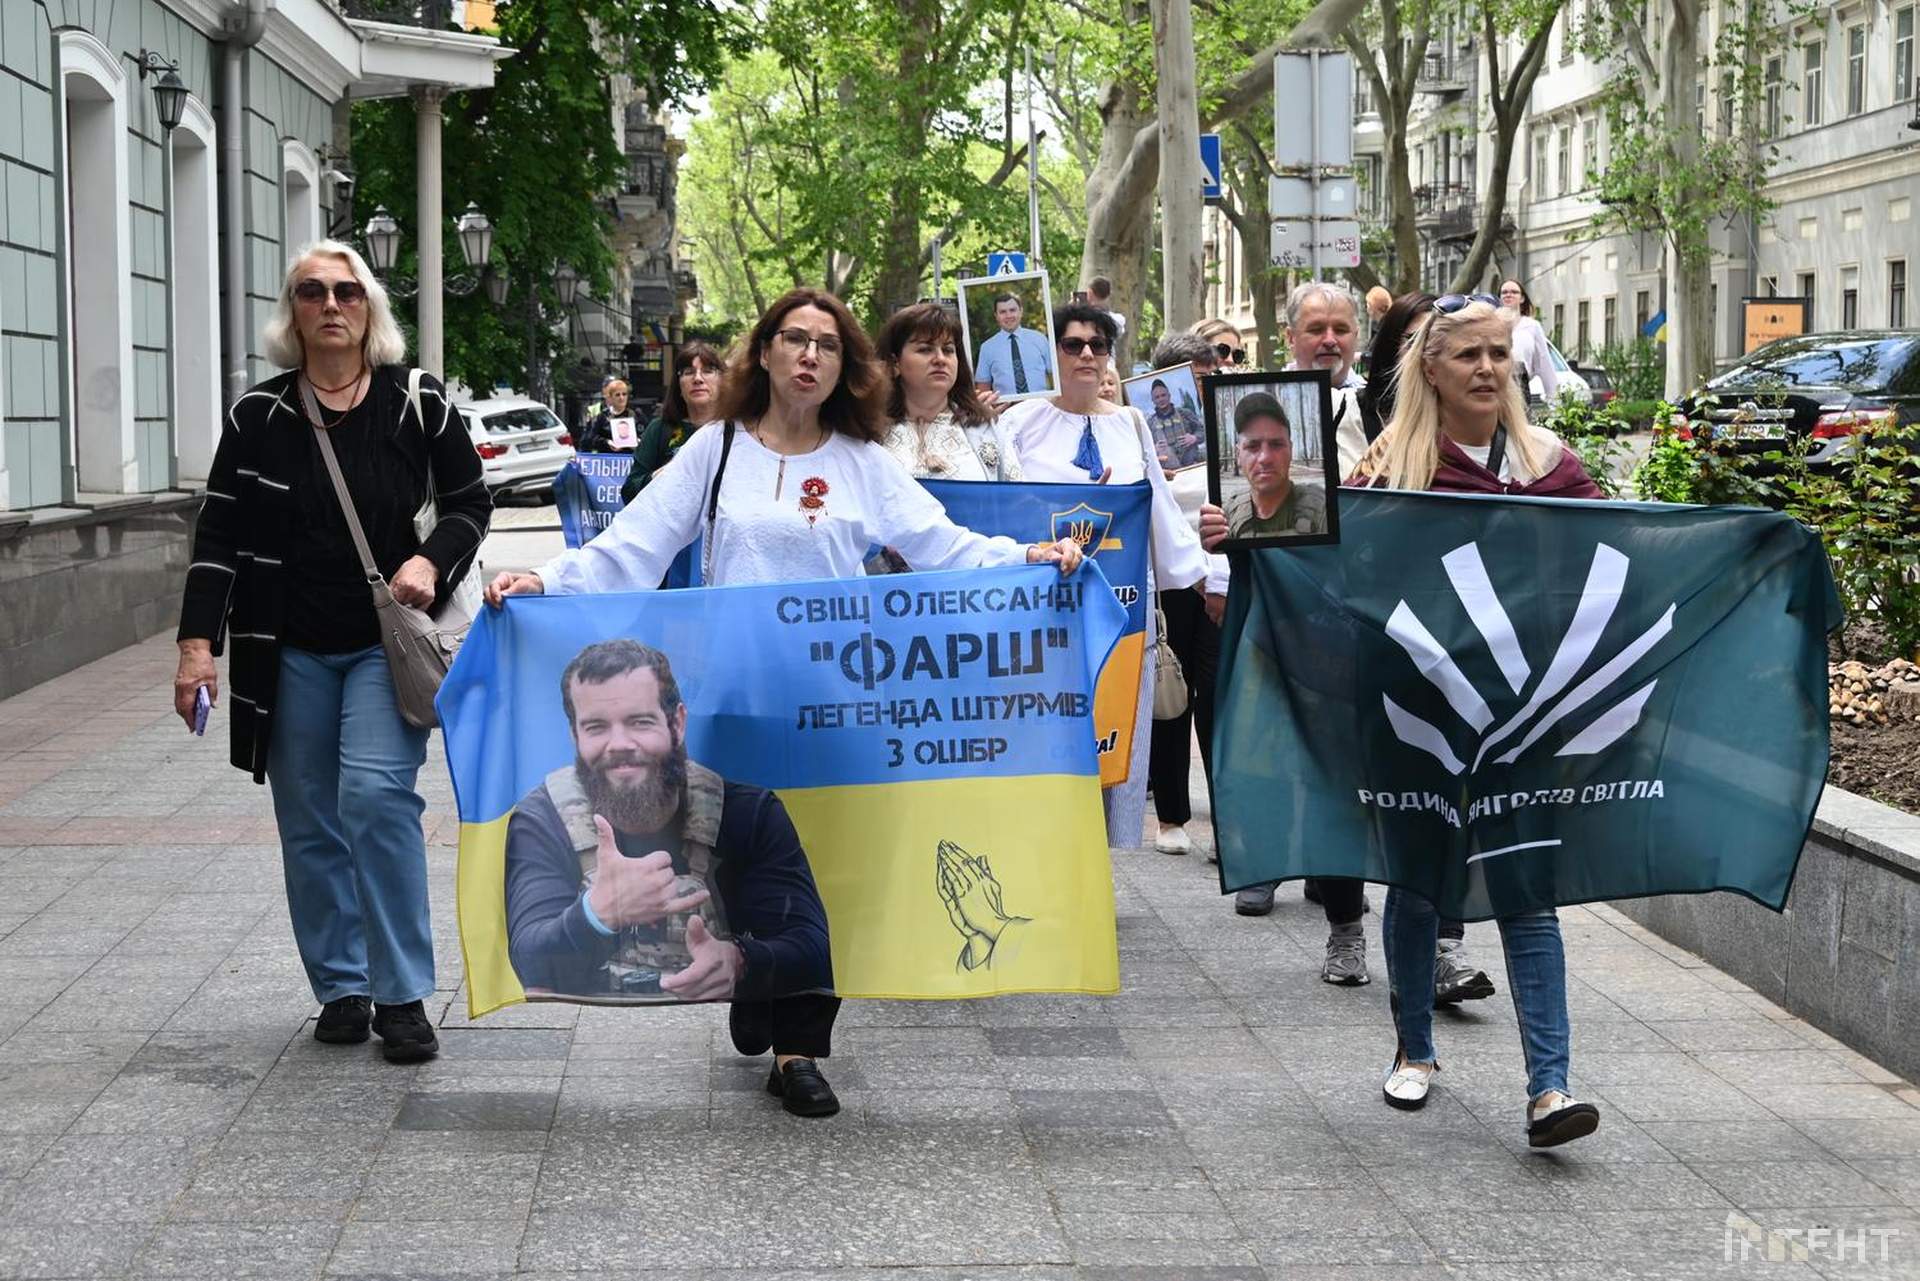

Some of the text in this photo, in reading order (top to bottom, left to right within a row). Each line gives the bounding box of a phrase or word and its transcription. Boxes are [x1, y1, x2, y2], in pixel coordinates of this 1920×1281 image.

[776, 593, 870, 624] СВІЩ
[810, 627, 1068, 690] "ФАРШ"
[797, 693, 1090, 730] ЛЕГЕНДА ШТУРМІВ
[914, 737, 1008, 766] ОШБР
[1357, 788, 1461, 828] РОДИНА
[1581, 780, 1665, 803] СВІТЛА
